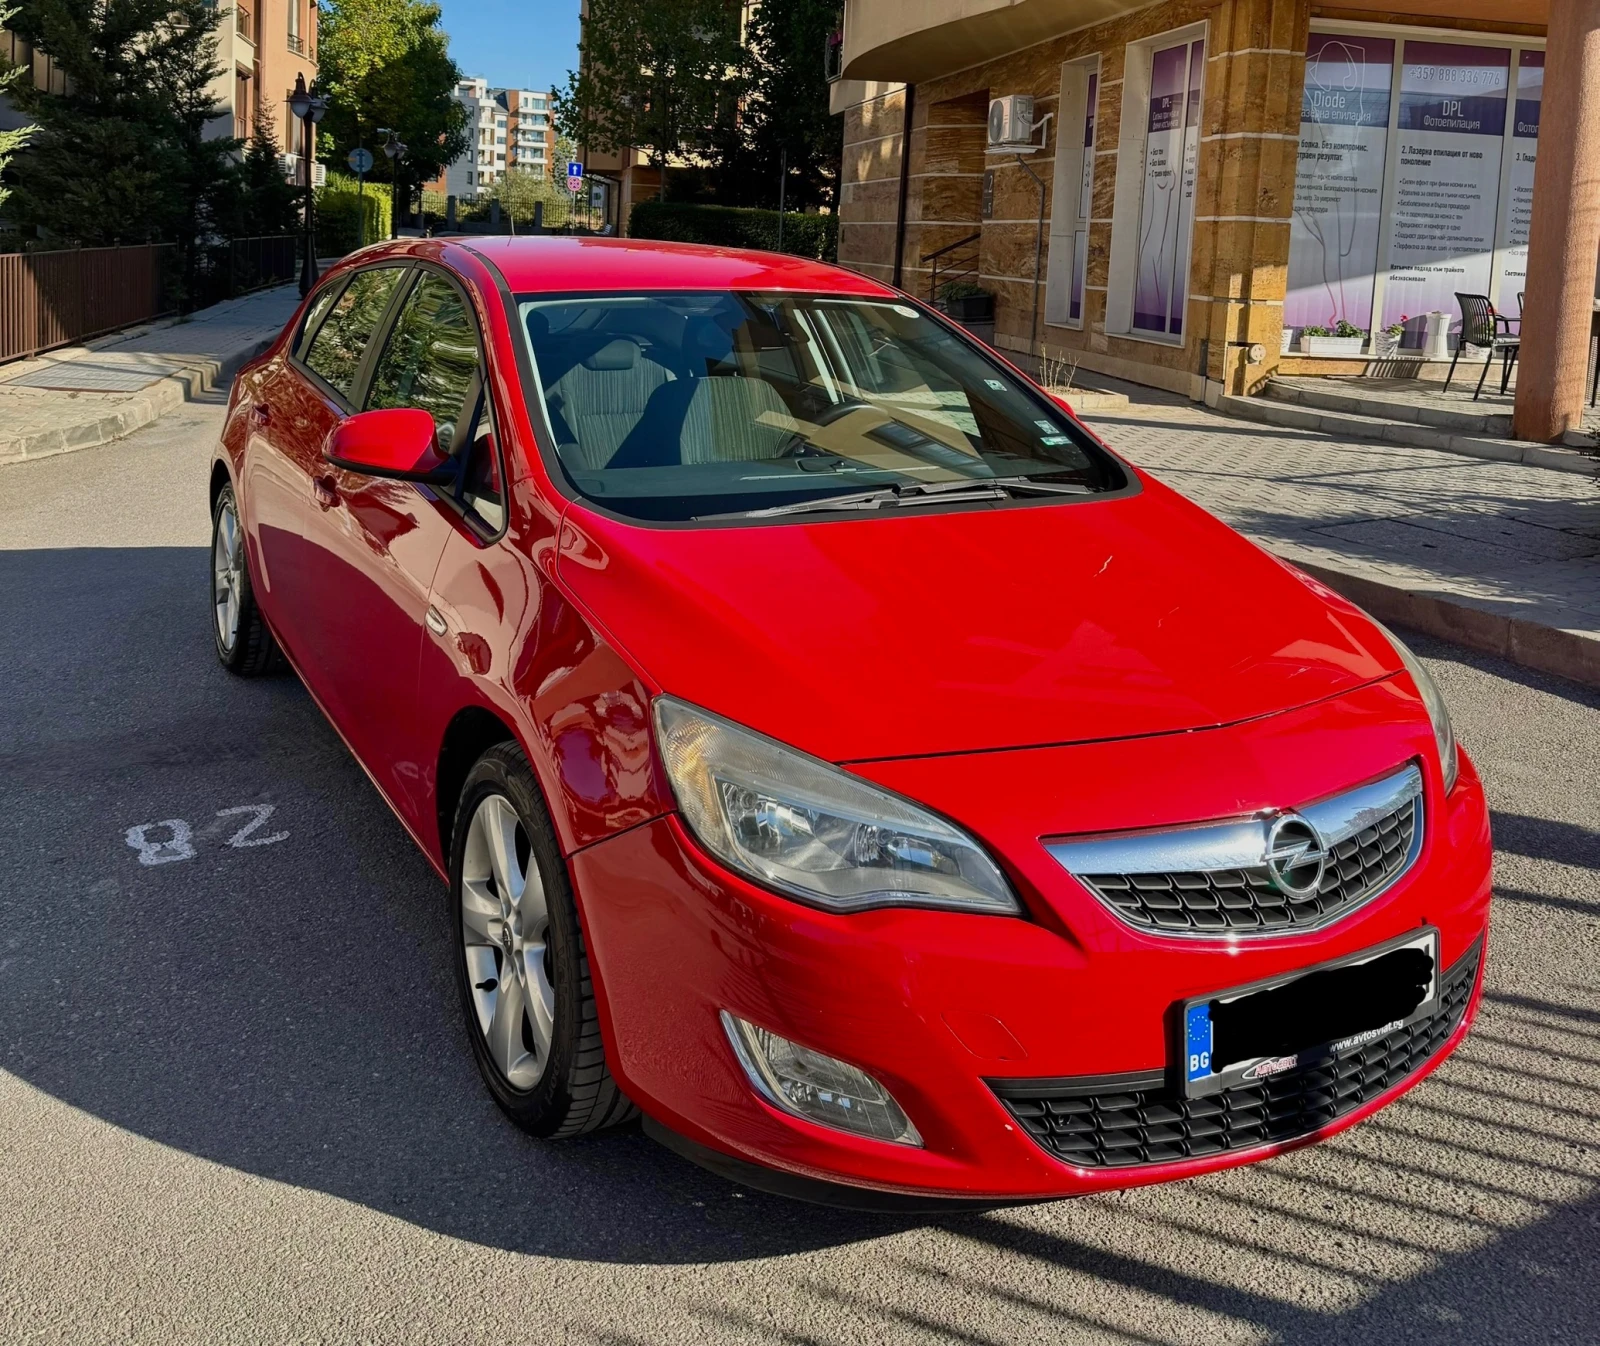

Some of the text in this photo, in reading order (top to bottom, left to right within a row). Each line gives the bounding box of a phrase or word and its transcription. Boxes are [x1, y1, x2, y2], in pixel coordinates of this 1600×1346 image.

[1409, 66, 1500, 85] +359 888 336 776
[1313, 91, 1346, 108] Diode
[1332, 110, 1371, 122] епилация
[1442, 100, 1464, 117] DPL
[1423, 115, 1480, 130] Фотоепилация
[1408, 146, 1432, 157] Лазерна
[1433, 149, 1461, 158] епилация
[1189, 1051, 1210, 1073] BG
